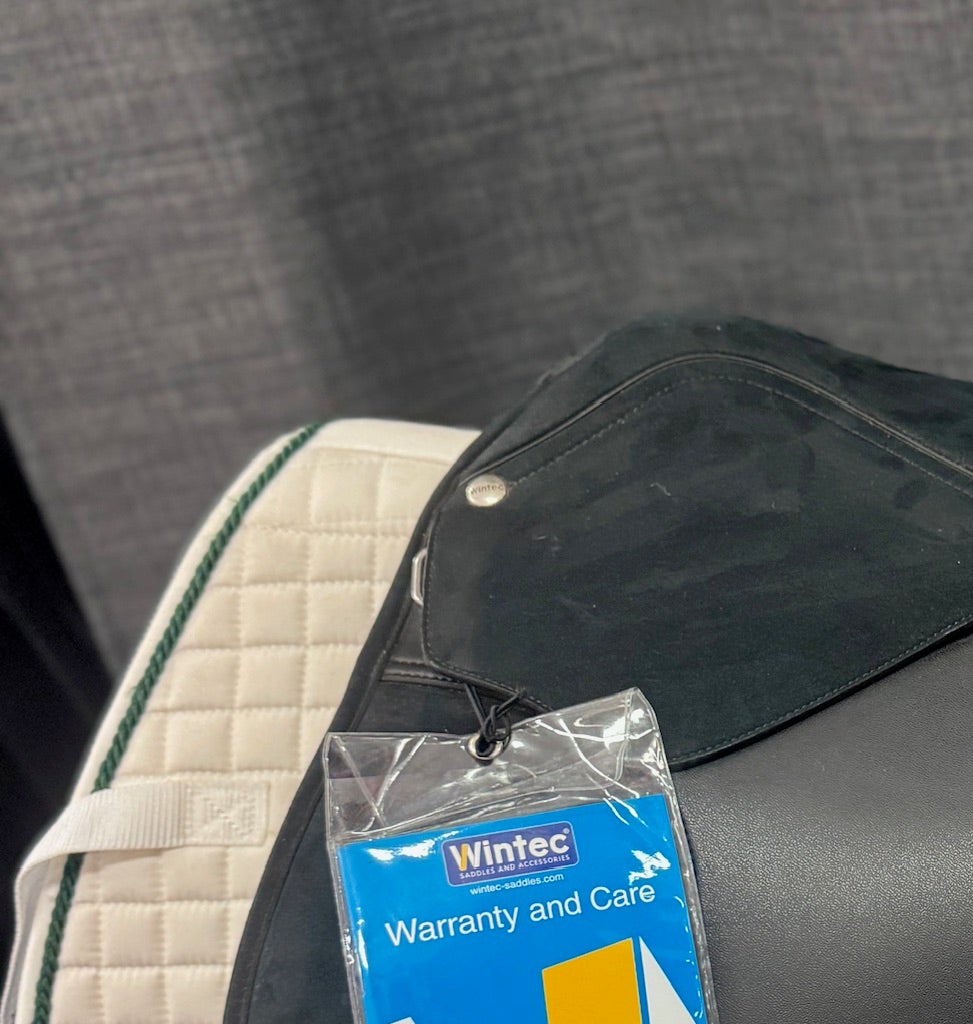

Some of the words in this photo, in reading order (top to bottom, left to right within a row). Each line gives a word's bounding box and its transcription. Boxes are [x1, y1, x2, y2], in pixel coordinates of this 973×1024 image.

[459, 867, 496, 880] SADDLES
[498, 864, 516, 873] AND
[518, 854, 571, 869] ACCESSORIES
[469, 872, 565, 896] wintec-saddles.com
[384, 905, 519, 947] Warranty
[529, 891, 582, 923] and
[589, 883, 656, 911] Care
